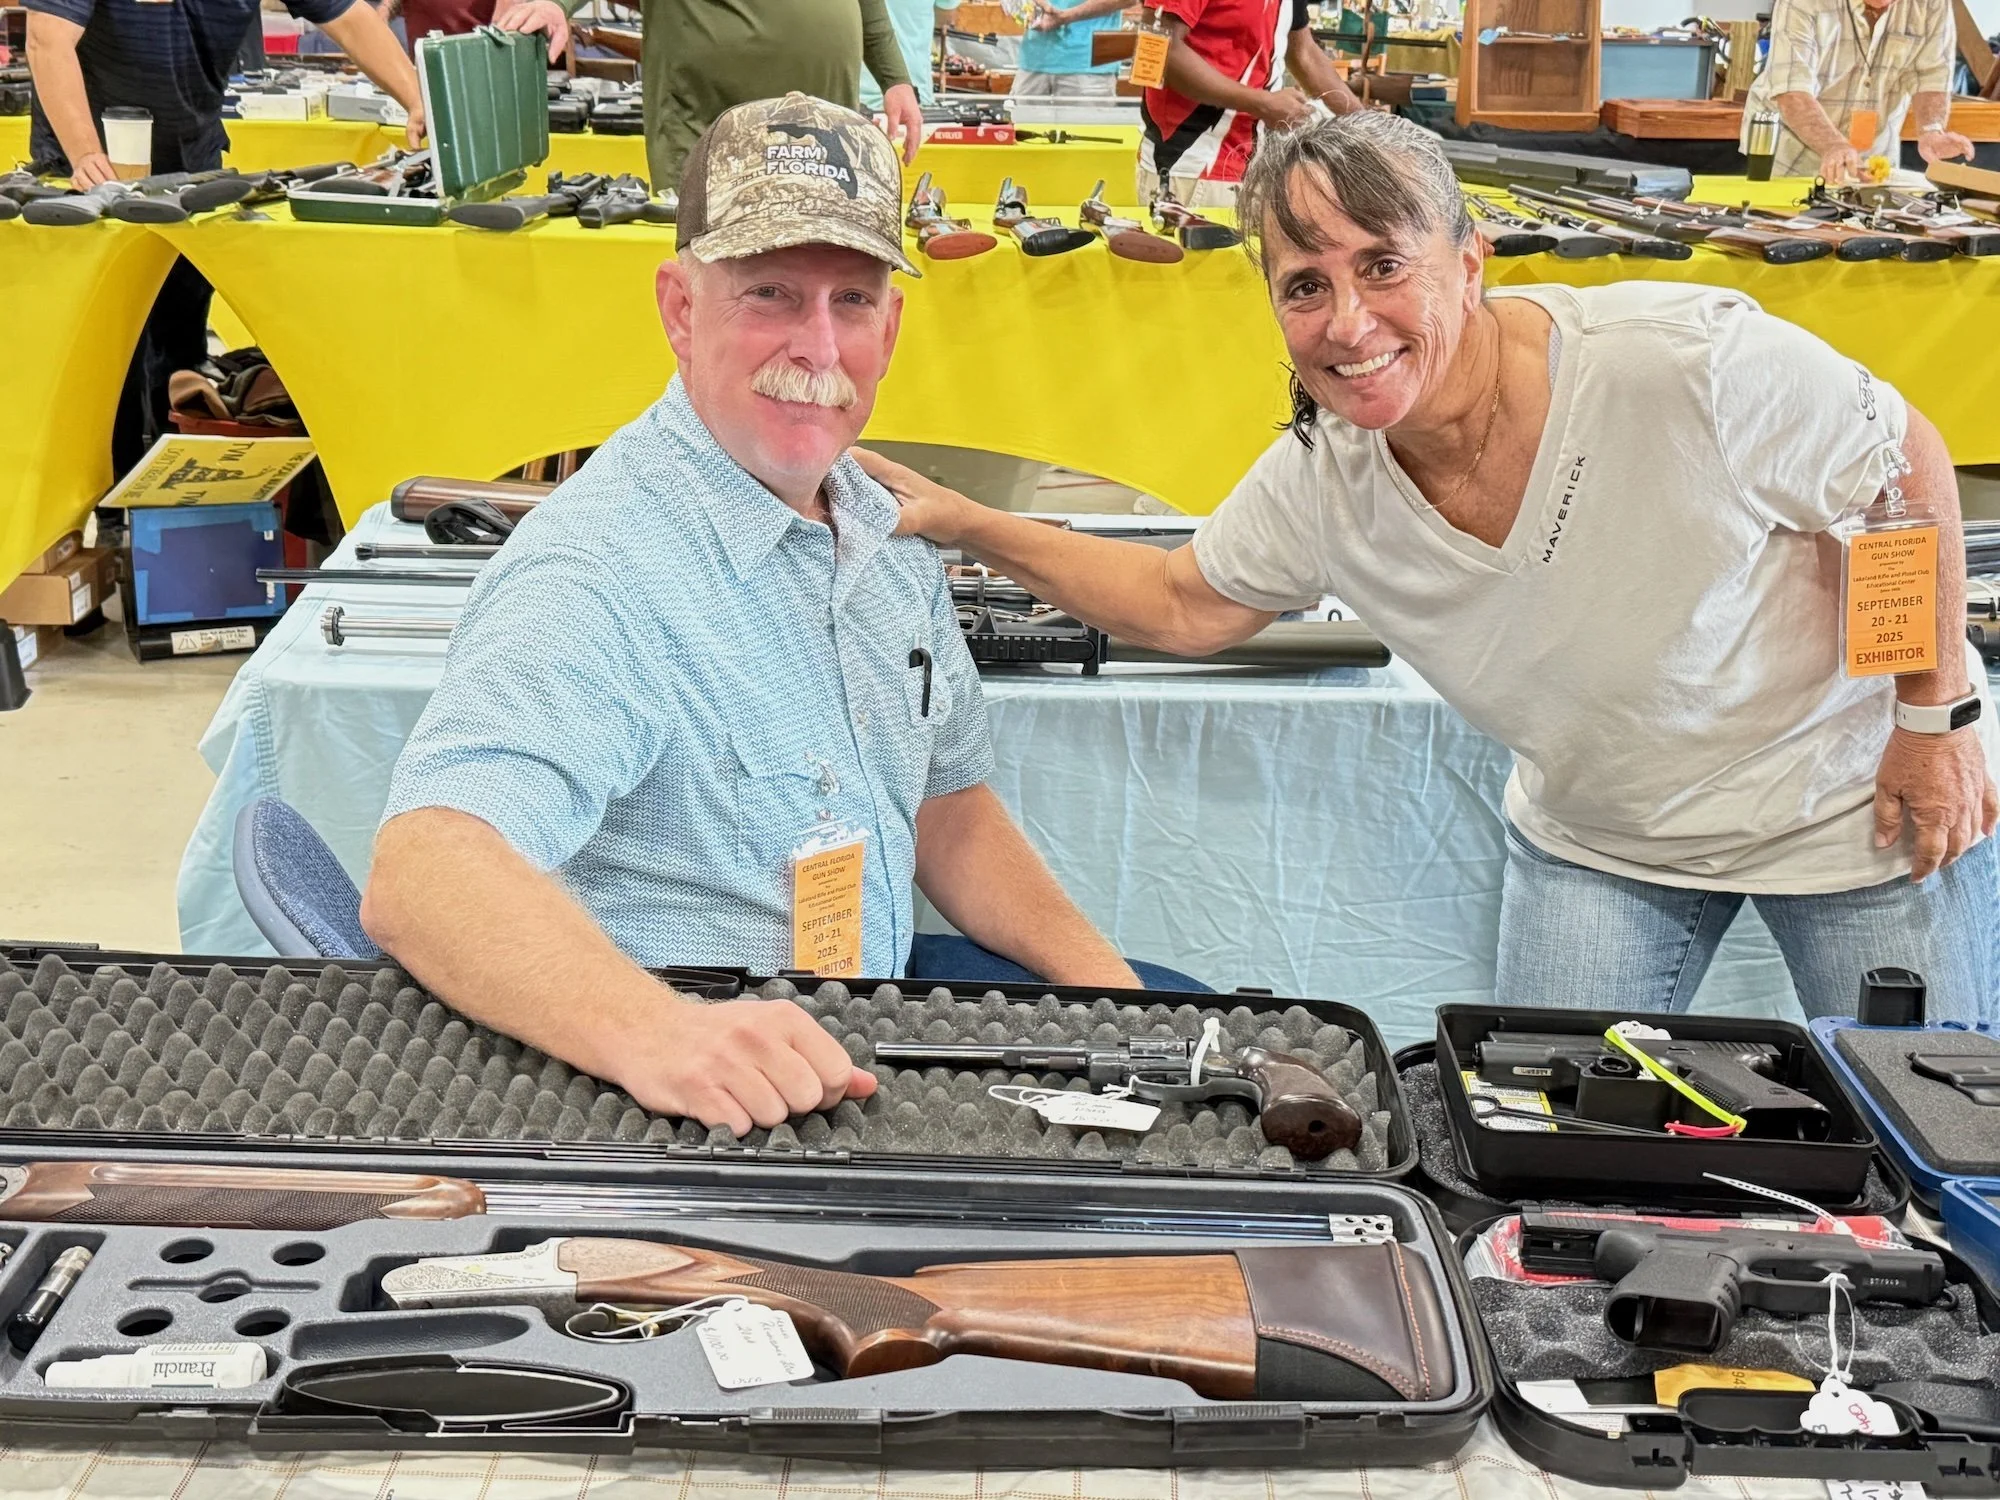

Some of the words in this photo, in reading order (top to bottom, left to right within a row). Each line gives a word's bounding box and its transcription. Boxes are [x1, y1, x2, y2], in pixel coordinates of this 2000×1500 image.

[766, 145, 822, 160] FARM
[766, 160, 850, 182] FLORIDA
[1542, 456, 1586, 563] MAVERICK
[1858, 541, 1893, 551] CENTRAL
[1894, 536, 1927, 546] FLORIDA
[1871, 552, 1889, 561] GUN
[1891, 549, 1915, 558] SHOW
[1853, 574, 1877, 583] Lakeland
[1866, 580, 1897, 589] Educational
[1857, 595, 1923, 612] SEPTEMBER
[1871, 616, 1885, 628] 20
[1895, 613, 1908, 625] 21
[1876, 631, 1903, 644] 2025
[1856, 647, 1925, 665] EXHIBITOR
[802, 860, 828, 873] CENTRAL
[830, 853, 855, 866] FLORIDA
[812, 871, 826, 881] GUN
[827, 866, 846, 877] SHOW
[802, 908, 852, 932] SEPTEMBER
[813, 932, 824, 944] 20
[831, 927, 841, 939] 21
[817, 944, 838, 960] 2025
[153, 1361, 216, 1377] Franchi
